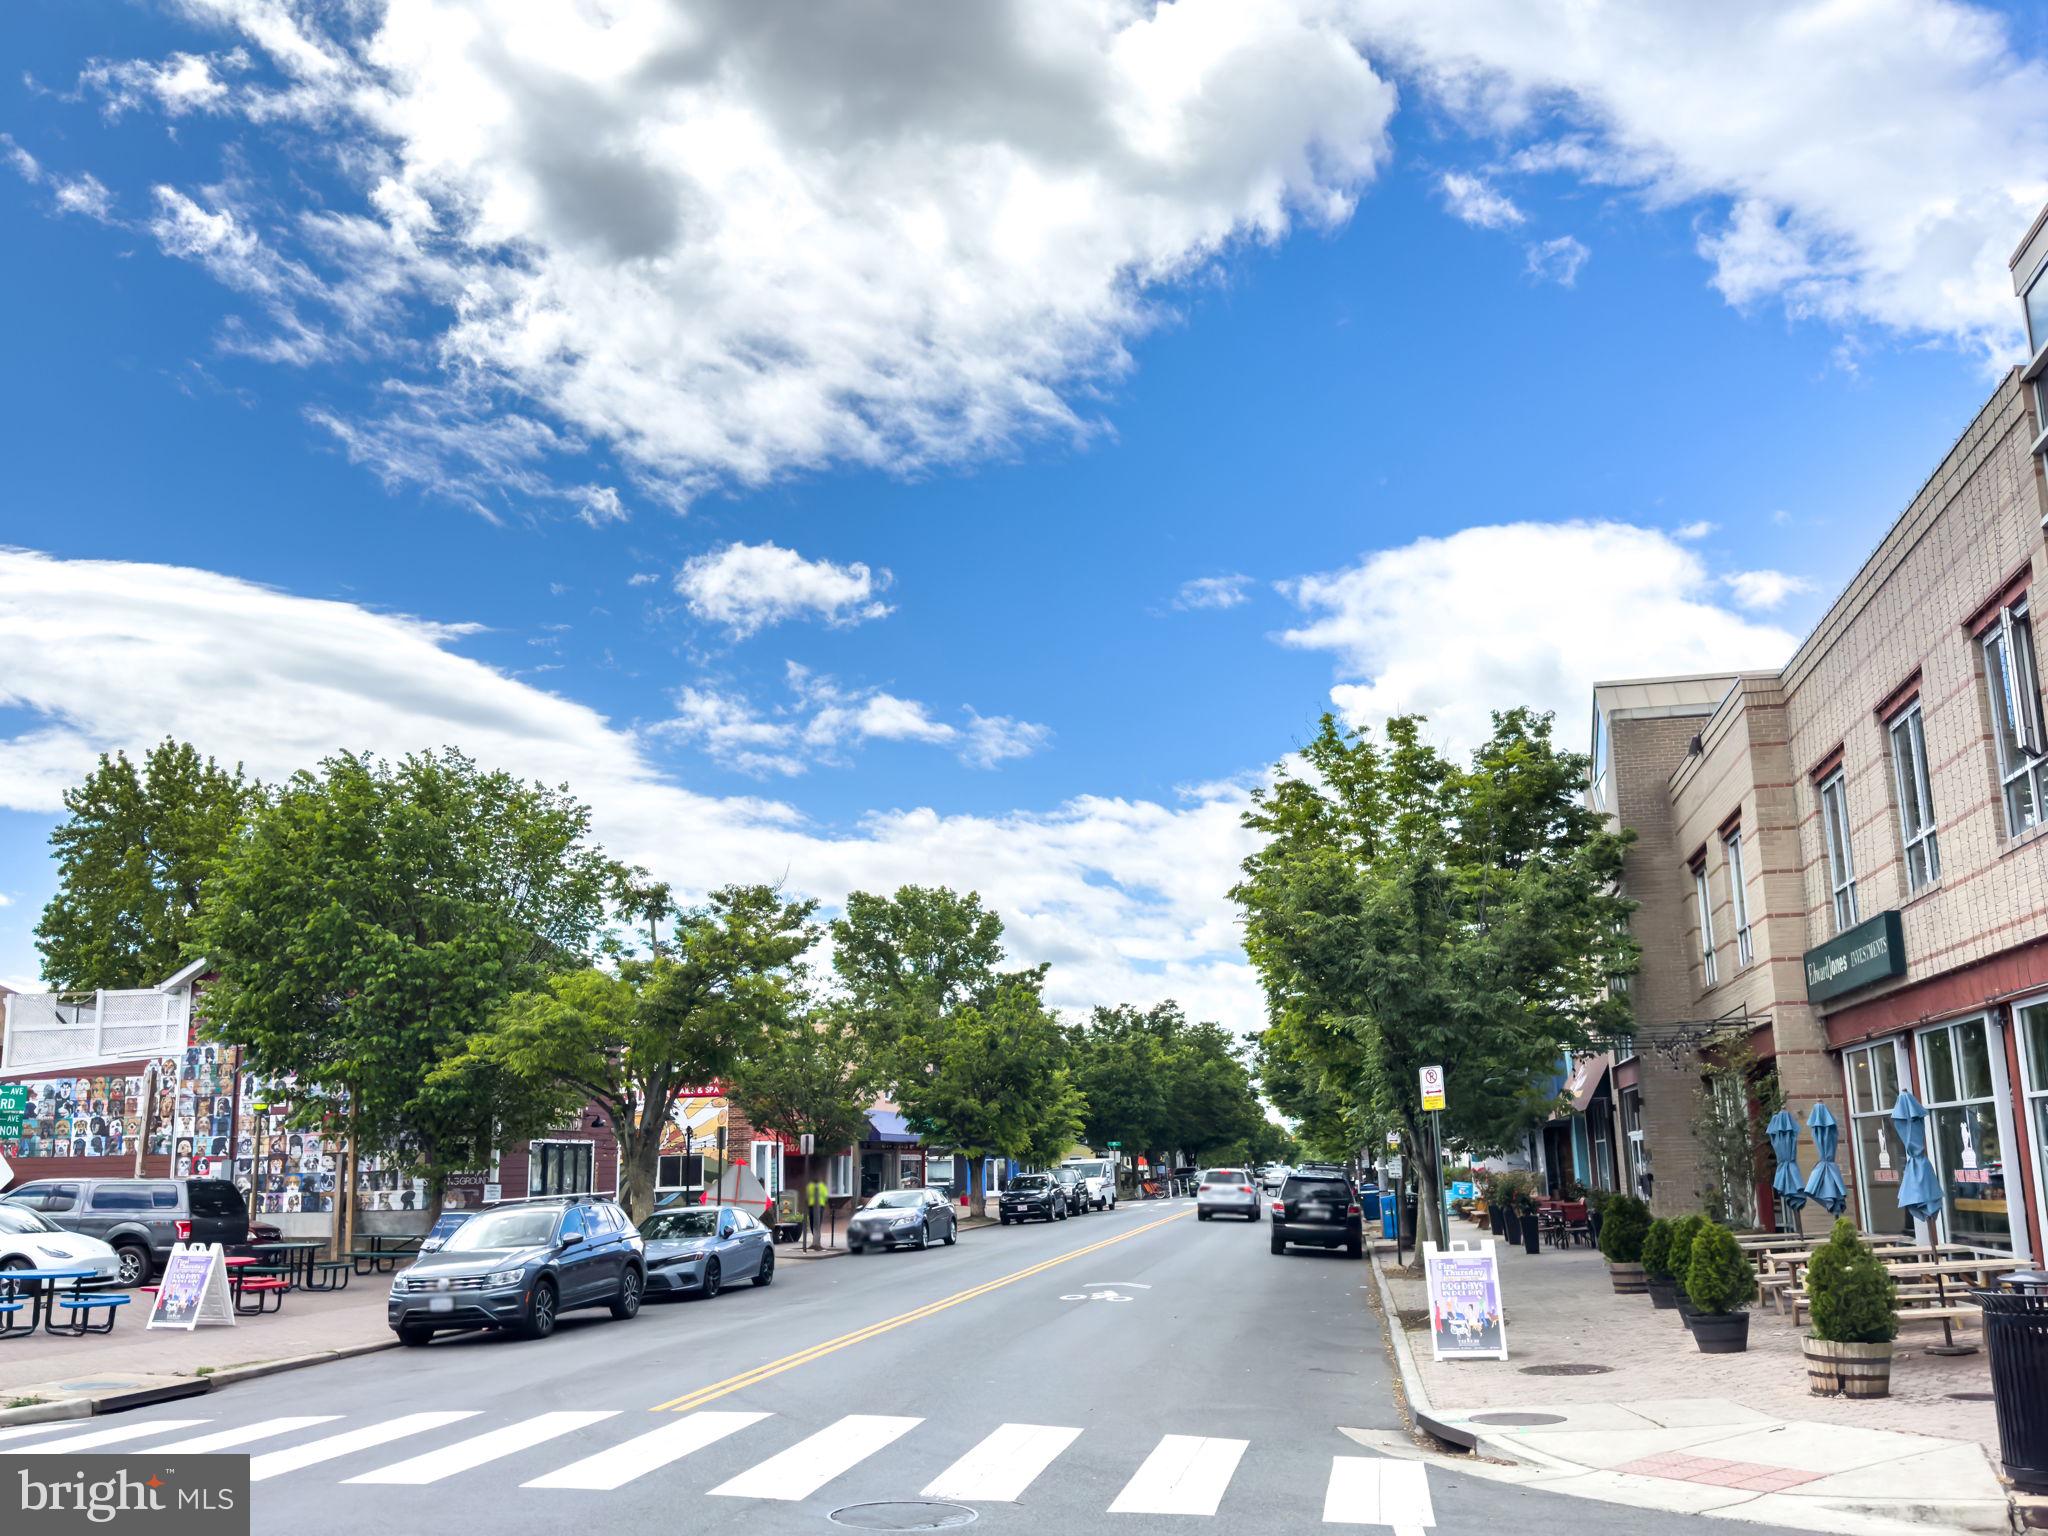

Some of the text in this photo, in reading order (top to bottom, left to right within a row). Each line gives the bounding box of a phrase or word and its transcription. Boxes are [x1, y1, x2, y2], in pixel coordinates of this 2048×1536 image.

[1850, 936, 1888, 967] INVESTMENTS
[1444, 1268, 1484, 1277] Thursday
[1441, 1281, 1484, 1291] DOG DAYS
